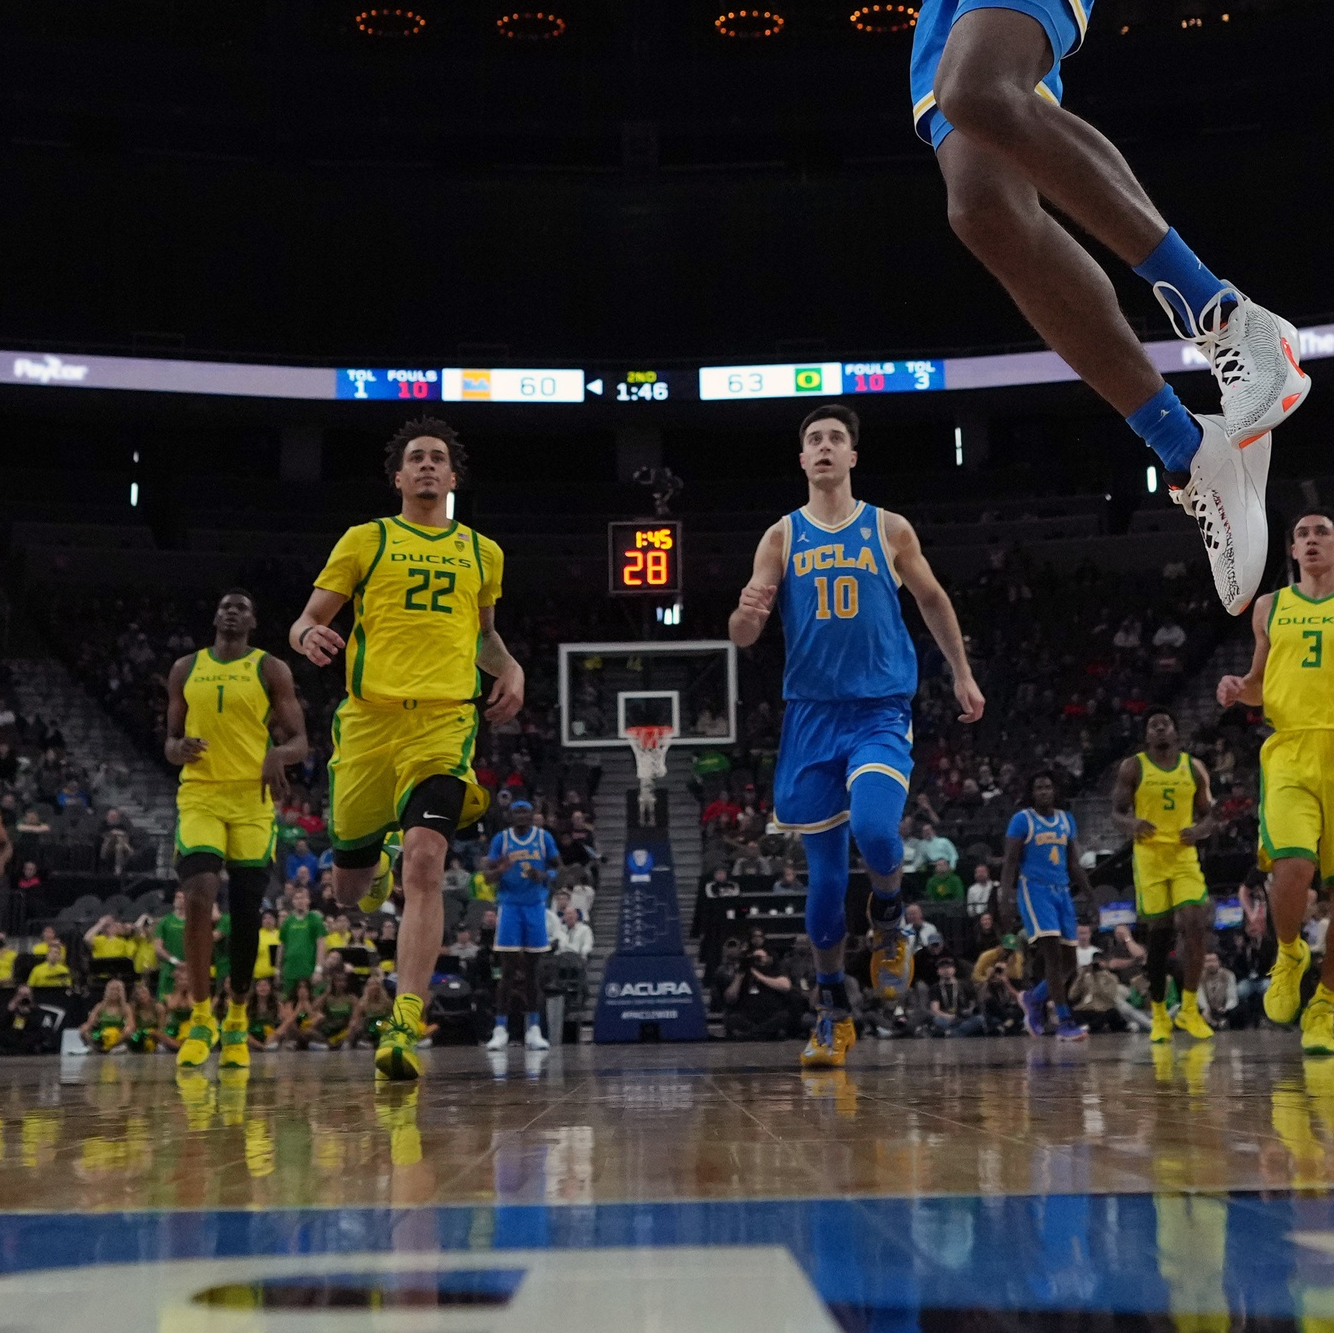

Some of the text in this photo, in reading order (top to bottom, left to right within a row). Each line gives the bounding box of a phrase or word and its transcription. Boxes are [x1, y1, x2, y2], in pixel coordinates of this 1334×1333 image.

[1300, 325, 1334, 356] The
[346, 369, 438, 383] TOL FOULS
[626, 370, 658, 384] 2ND
[844, 360, 937, 376] FOULS TOL
[353, 381, 428, 399] 1 10
[520, 376, 556, 395] 60
[616, 383, 669, 401] 1:46
[727, 373, 764, 394] 63
[855, 373, 930, 392] 10 3
[635, 528, 673, 550] 1:45
[390, 552, 472, 569] DUCKS
[623, 550, 668, 586] 28
[793, 543, 879, 577] UCLA
[404, 568, 457, 614] 22
[814, 575, 860, 620] 10
[1301, 630, 1323, 668] 3
[193, 674, 251, 684] DUCKS
[216, 684, 225, 713] 1
[1163, 787, 1176, 811] 5
[1049, 845, 1061, 866] 4
[619, 981, 693, 997] ACURA
